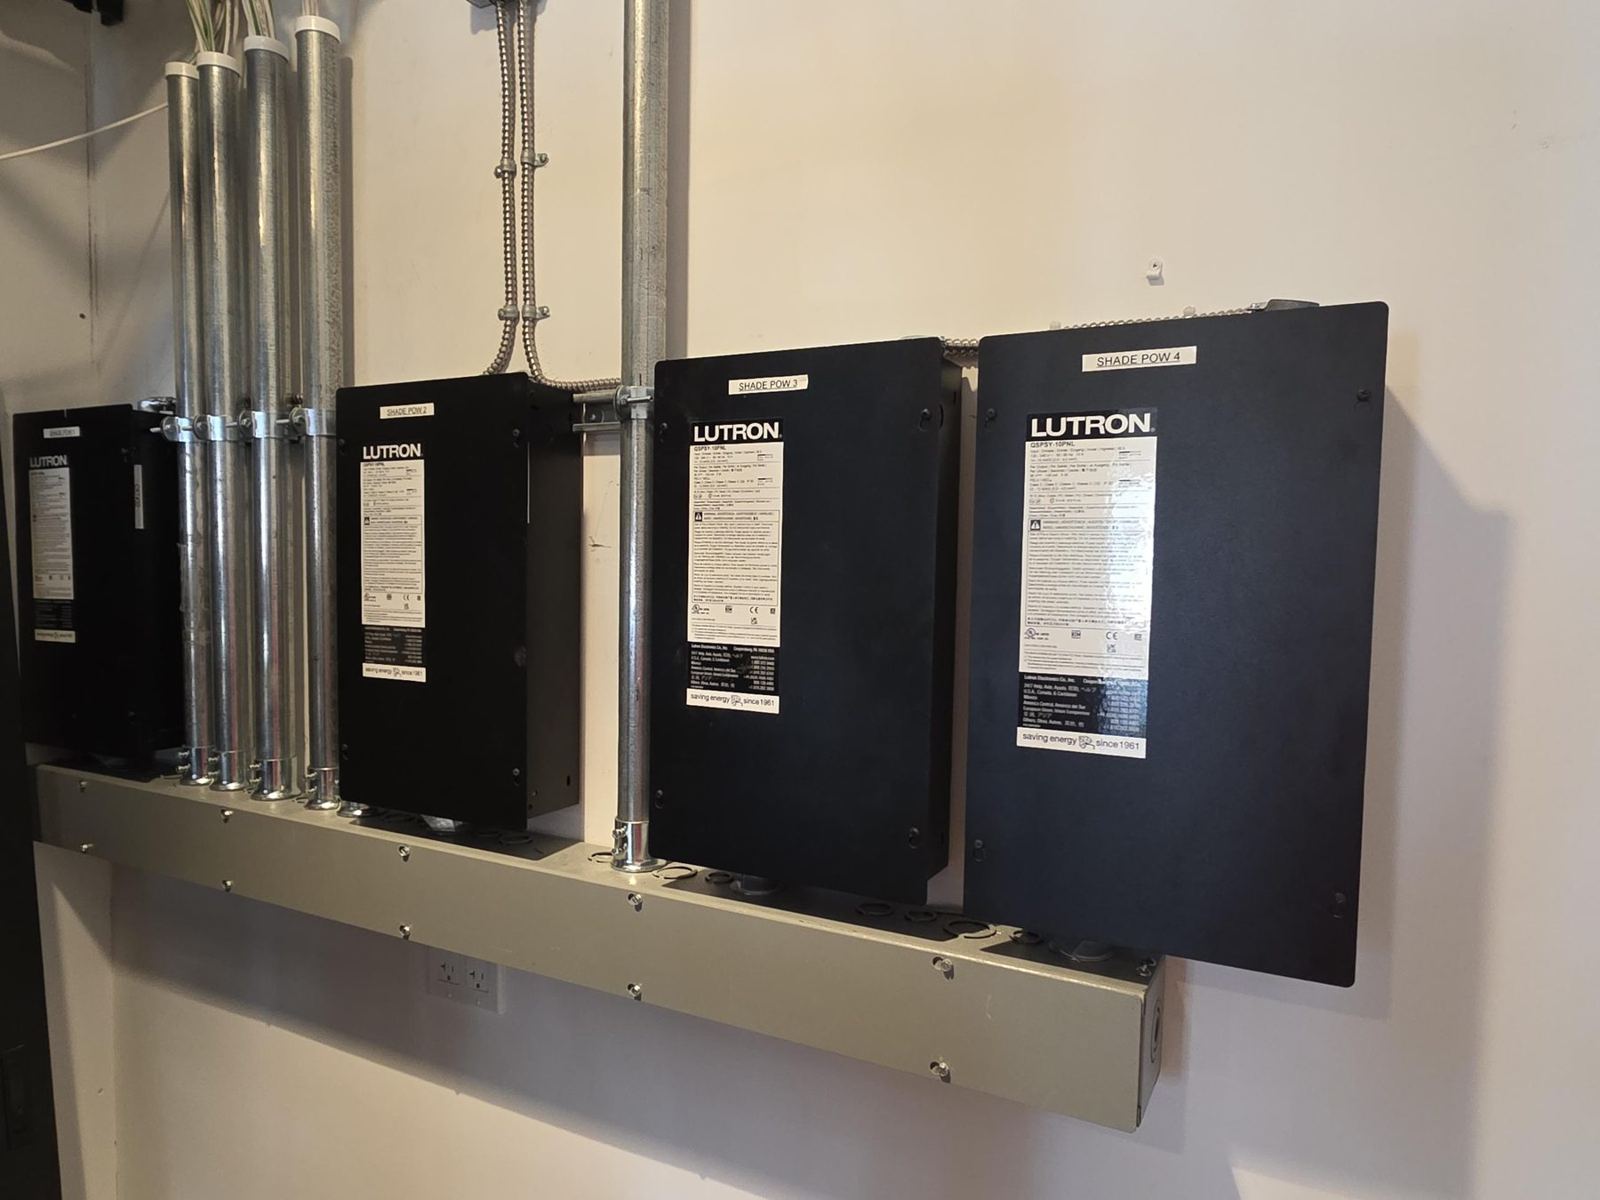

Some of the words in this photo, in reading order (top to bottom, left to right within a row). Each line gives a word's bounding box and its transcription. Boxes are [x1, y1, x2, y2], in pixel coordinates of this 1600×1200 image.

[1097, 354, 1138, 367] SHADE
[1141, 352, 1171, 363] POW
[1173, 352, 1181, 361] 4
[739, 381, 768, 391] SHADE
[770, 380, 791, 389] POW
[793, 379, 798, 387] 3
[386, 407, 406, 416] SHADE
[407, 406, 421, 415] POW
[694, 422, 780, 442] LUTRON
[1031, 413, 1151, 438] LUTRON
[363, 443, 421, 460] LUTRON
[29, 455, 67, 468] LUTRON
[691, 693, 709, 701] saving
[710, 695, 730, 704] energy
[1022, 733, 1048, 743] saving
[1049, 735, 1077, 745] energy
[1096, 739, 1118, 748] since
[1120, 741, 1140, 750] 1961
